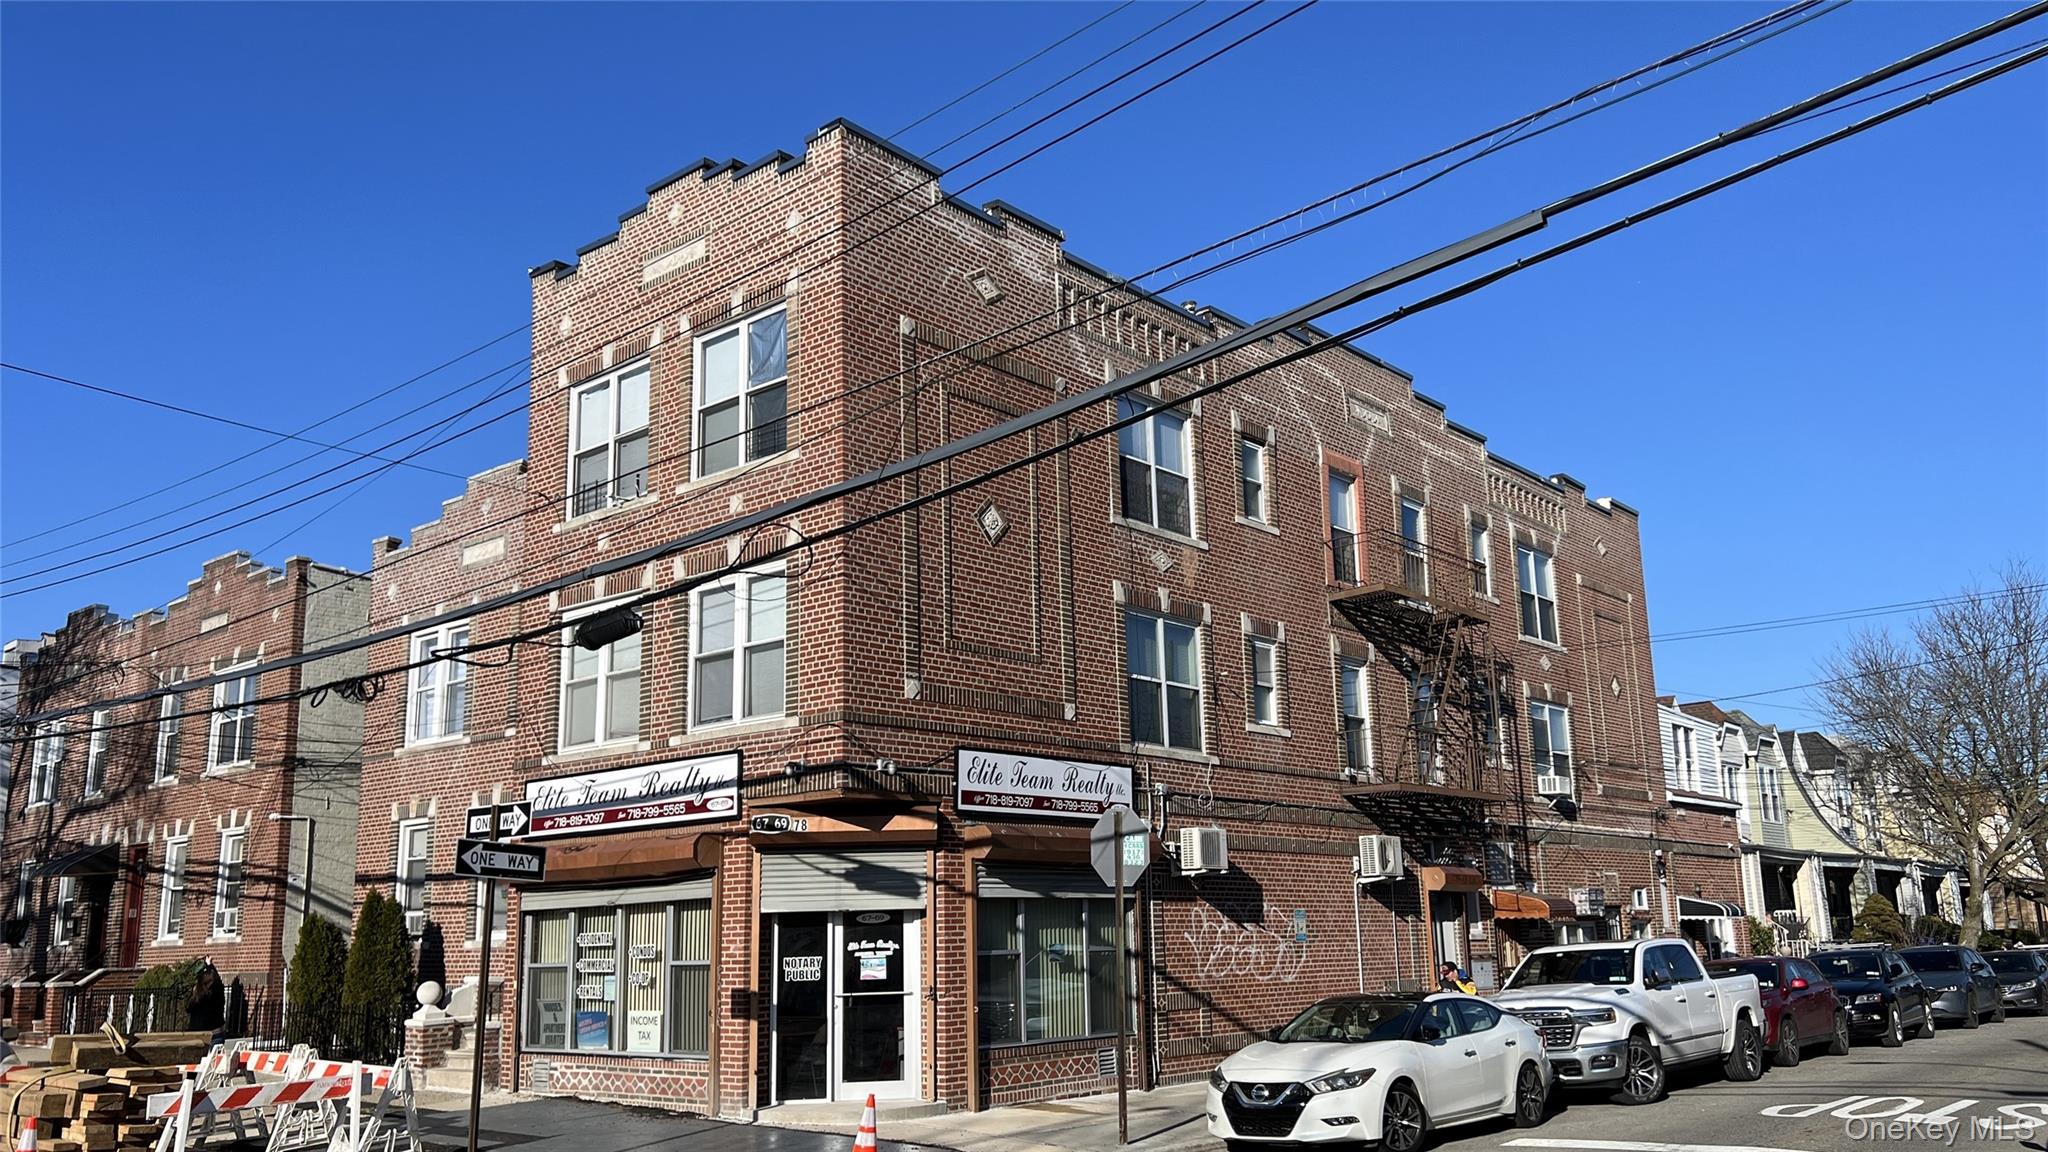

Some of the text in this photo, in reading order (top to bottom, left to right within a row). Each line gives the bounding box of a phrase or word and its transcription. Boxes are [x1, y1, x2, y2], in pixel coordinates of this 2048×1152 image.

[967, 756, 1003, 786] Elite
[1010, 760, 1054, 790] Team
[1062, 766, 1114, 807] Realty
[533, 785, 569, 811] Elite
[577, 779, 628, 807] Team
[639, 766, 711, 804] Realty
[985, 793, 1034, 808] 718-819-7097
[1051, 799, 1099, 812] 718-799-5565
[502, 814, 522, 827] WAY
[554, 812, 605, 828] 718-819-7097
[627, 802, 686, 819] 718-799-5565
[755, 817, 788, 830] 67 69
[794, 819, 808, 831] 78
[470, 851, 534, 869] ONE WAY
[579, 932, 613, 945] RESIDENTIAL
[632, 945, 655, 958] CONDOS
[579, 959, 614, 972] COMMERCIAL
[784, 957, 821, 969] NOTARY
[786, 969, 820, 981] PUBLIC
[579, 985, 603, 998] RENTALS
[630, 1016, 659, 1026] INCOME
[638, 1031, 651, 1041] TAX
[1761, 1095, 2048, 1130] STOP
